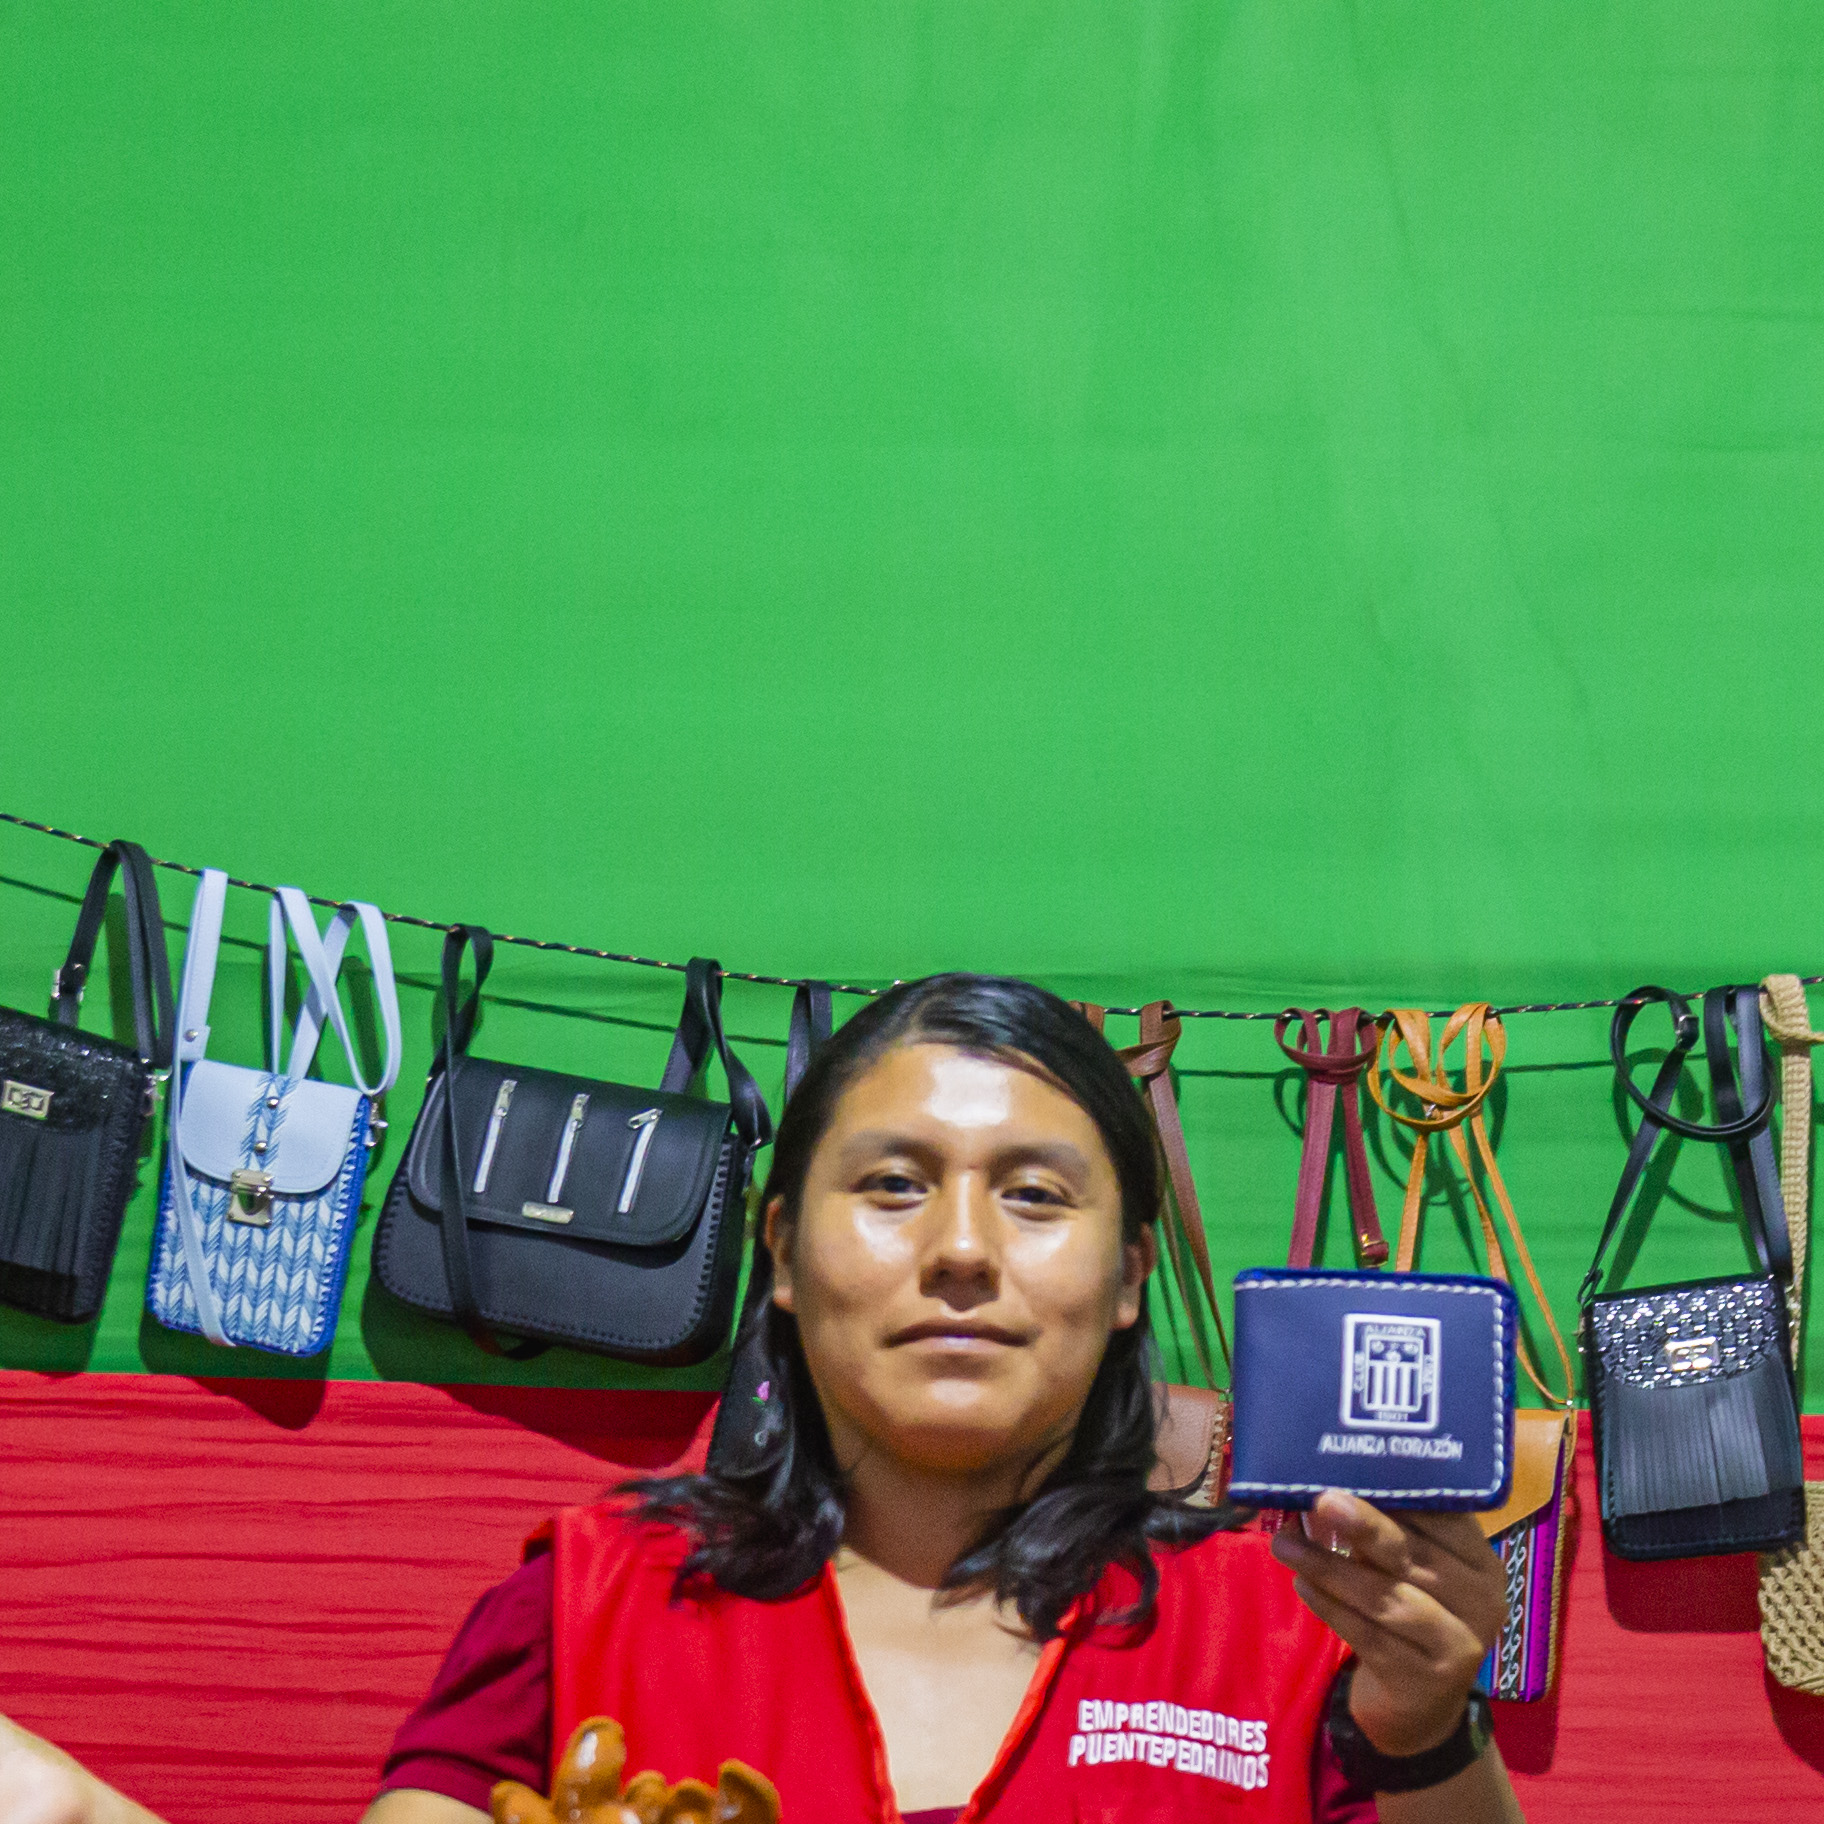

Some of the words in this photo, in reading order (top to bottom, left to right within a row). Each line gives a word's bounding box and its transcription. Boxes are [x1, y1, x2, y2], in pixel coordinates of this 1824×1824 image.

[1319, 1432, 1387, 1457] ALIANZA
[1388, 1432, 1464, 1461] CORAZÓN
[1077, 1698, 1269, 1753] EMPRENDEDORES
[1067, 1730, 1272, 1791] PUENTEPEDRINOS
